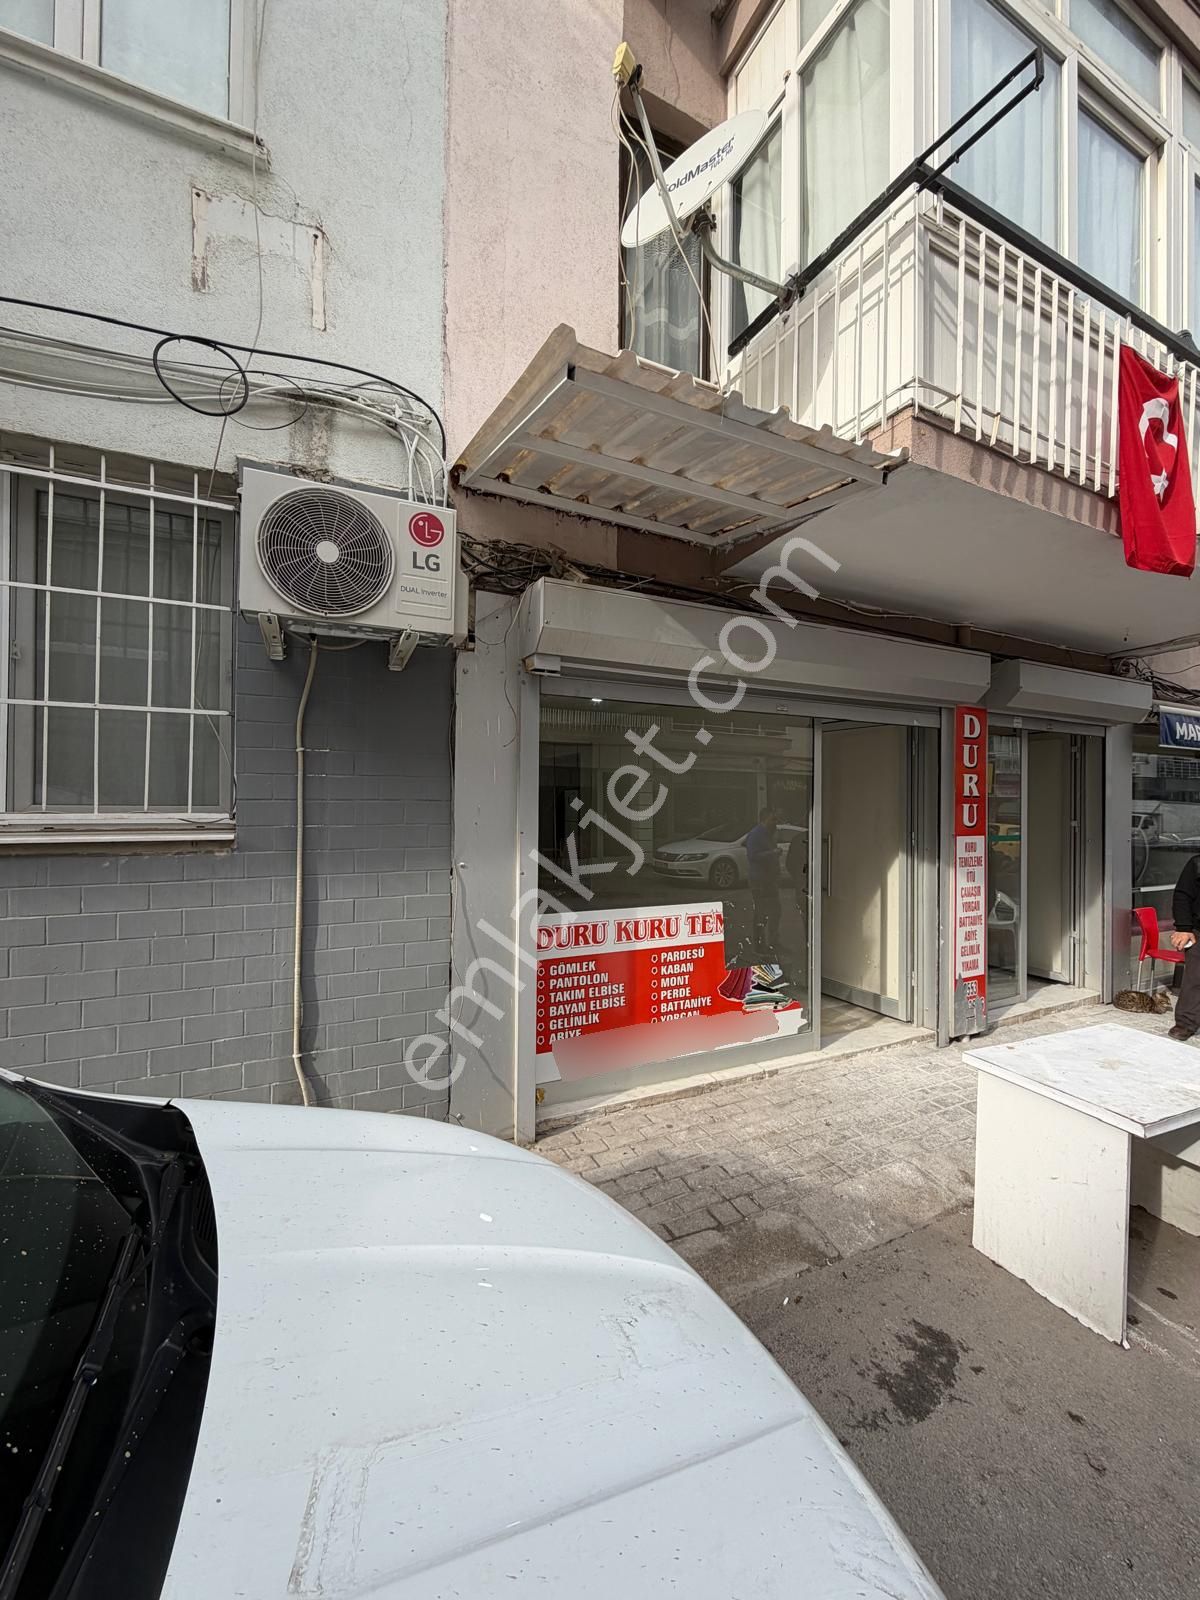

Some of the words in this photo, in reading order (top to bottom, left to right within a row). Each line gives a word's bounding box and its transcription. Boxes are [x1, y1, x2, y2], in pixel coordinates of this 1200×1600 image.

[659, 135, 735, 197] oldMaster
[412, 551, 440, 572] LG
[400, 585, 419, 594] DUAL
[961, 714, 981, 827] DURU
[537, 922, 607, 950] DURU
[615, 916, 680, 943] KURU
[660, 947, 705, 963] PARDESÜ
[550, 961, 596, 976] GÖMLEK
[660, 962, 694, 975] KABAN
[550, 972, 609, 989] PANTOLON
[660, 975, 690, 987] MONT
[549, 988, 585, 1003] TAKIM
[588, 983, 625, 997] ELBİSE
[660, 987, 692, 1000] PERDE
[550, 1001, 586, 1017] BAYAN
[590, 996, 626, 1011] ELBİSE
[660, 996, 713, 1013] BATTANİYE
[550, 1012, 600, 1030] GELİNLİK
